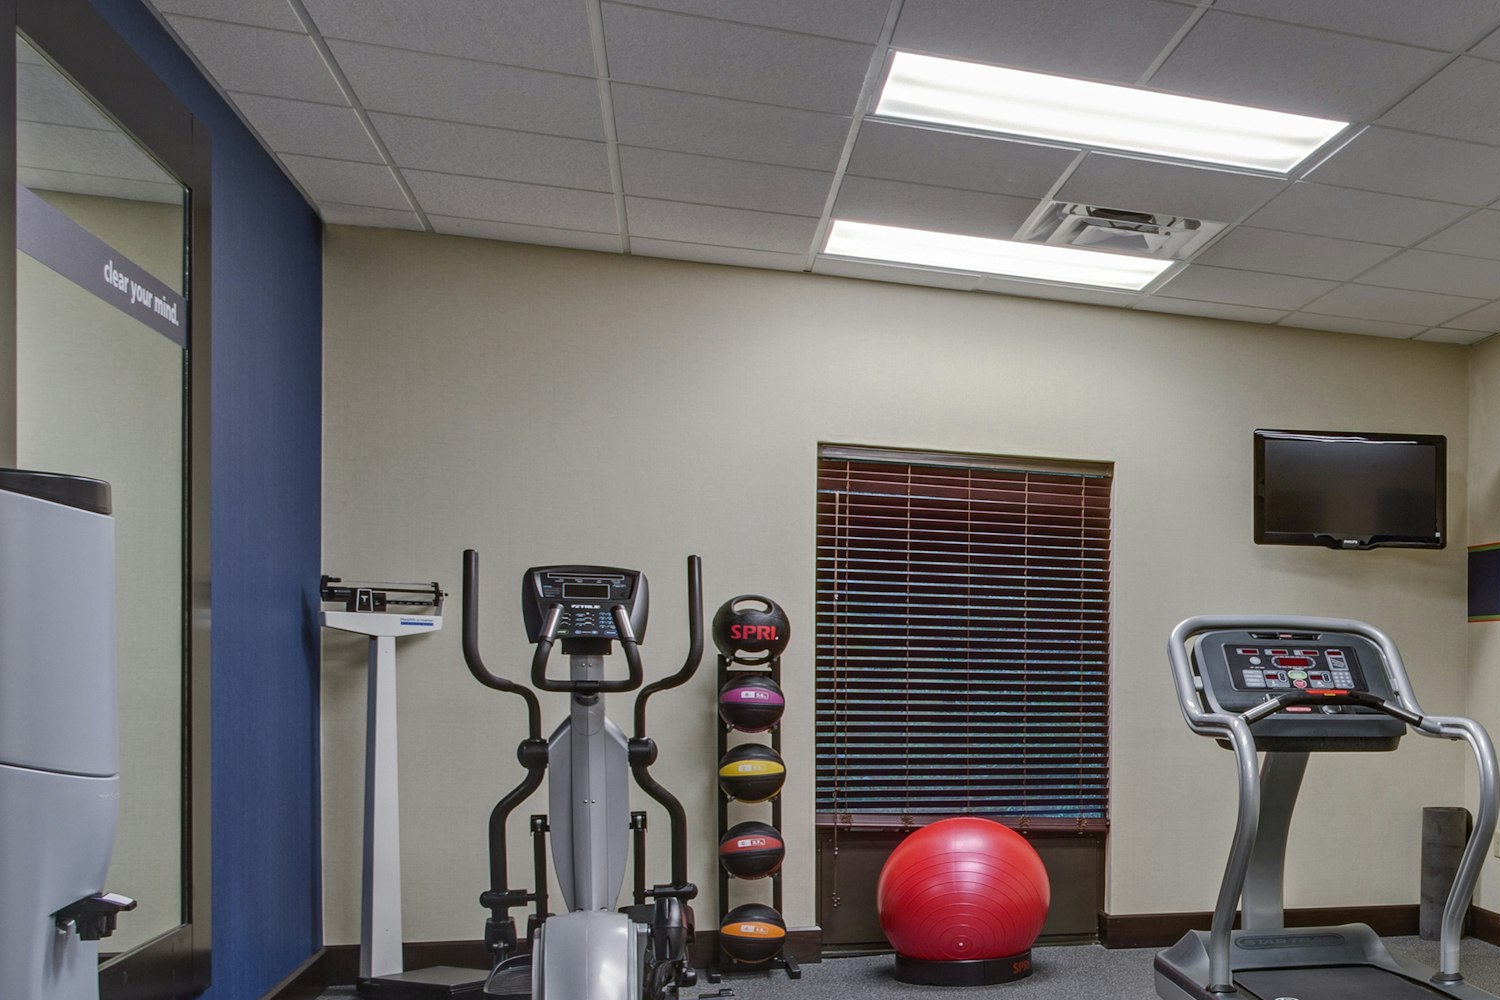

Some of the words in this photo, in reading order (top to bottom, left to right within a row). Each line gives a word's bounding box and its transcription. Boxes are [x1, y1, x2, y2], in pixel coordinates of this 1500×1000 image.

[104, 260, 129, 293] clear
[130, 281, 153, 308] your
[154, 296, 179, 326] mind.
